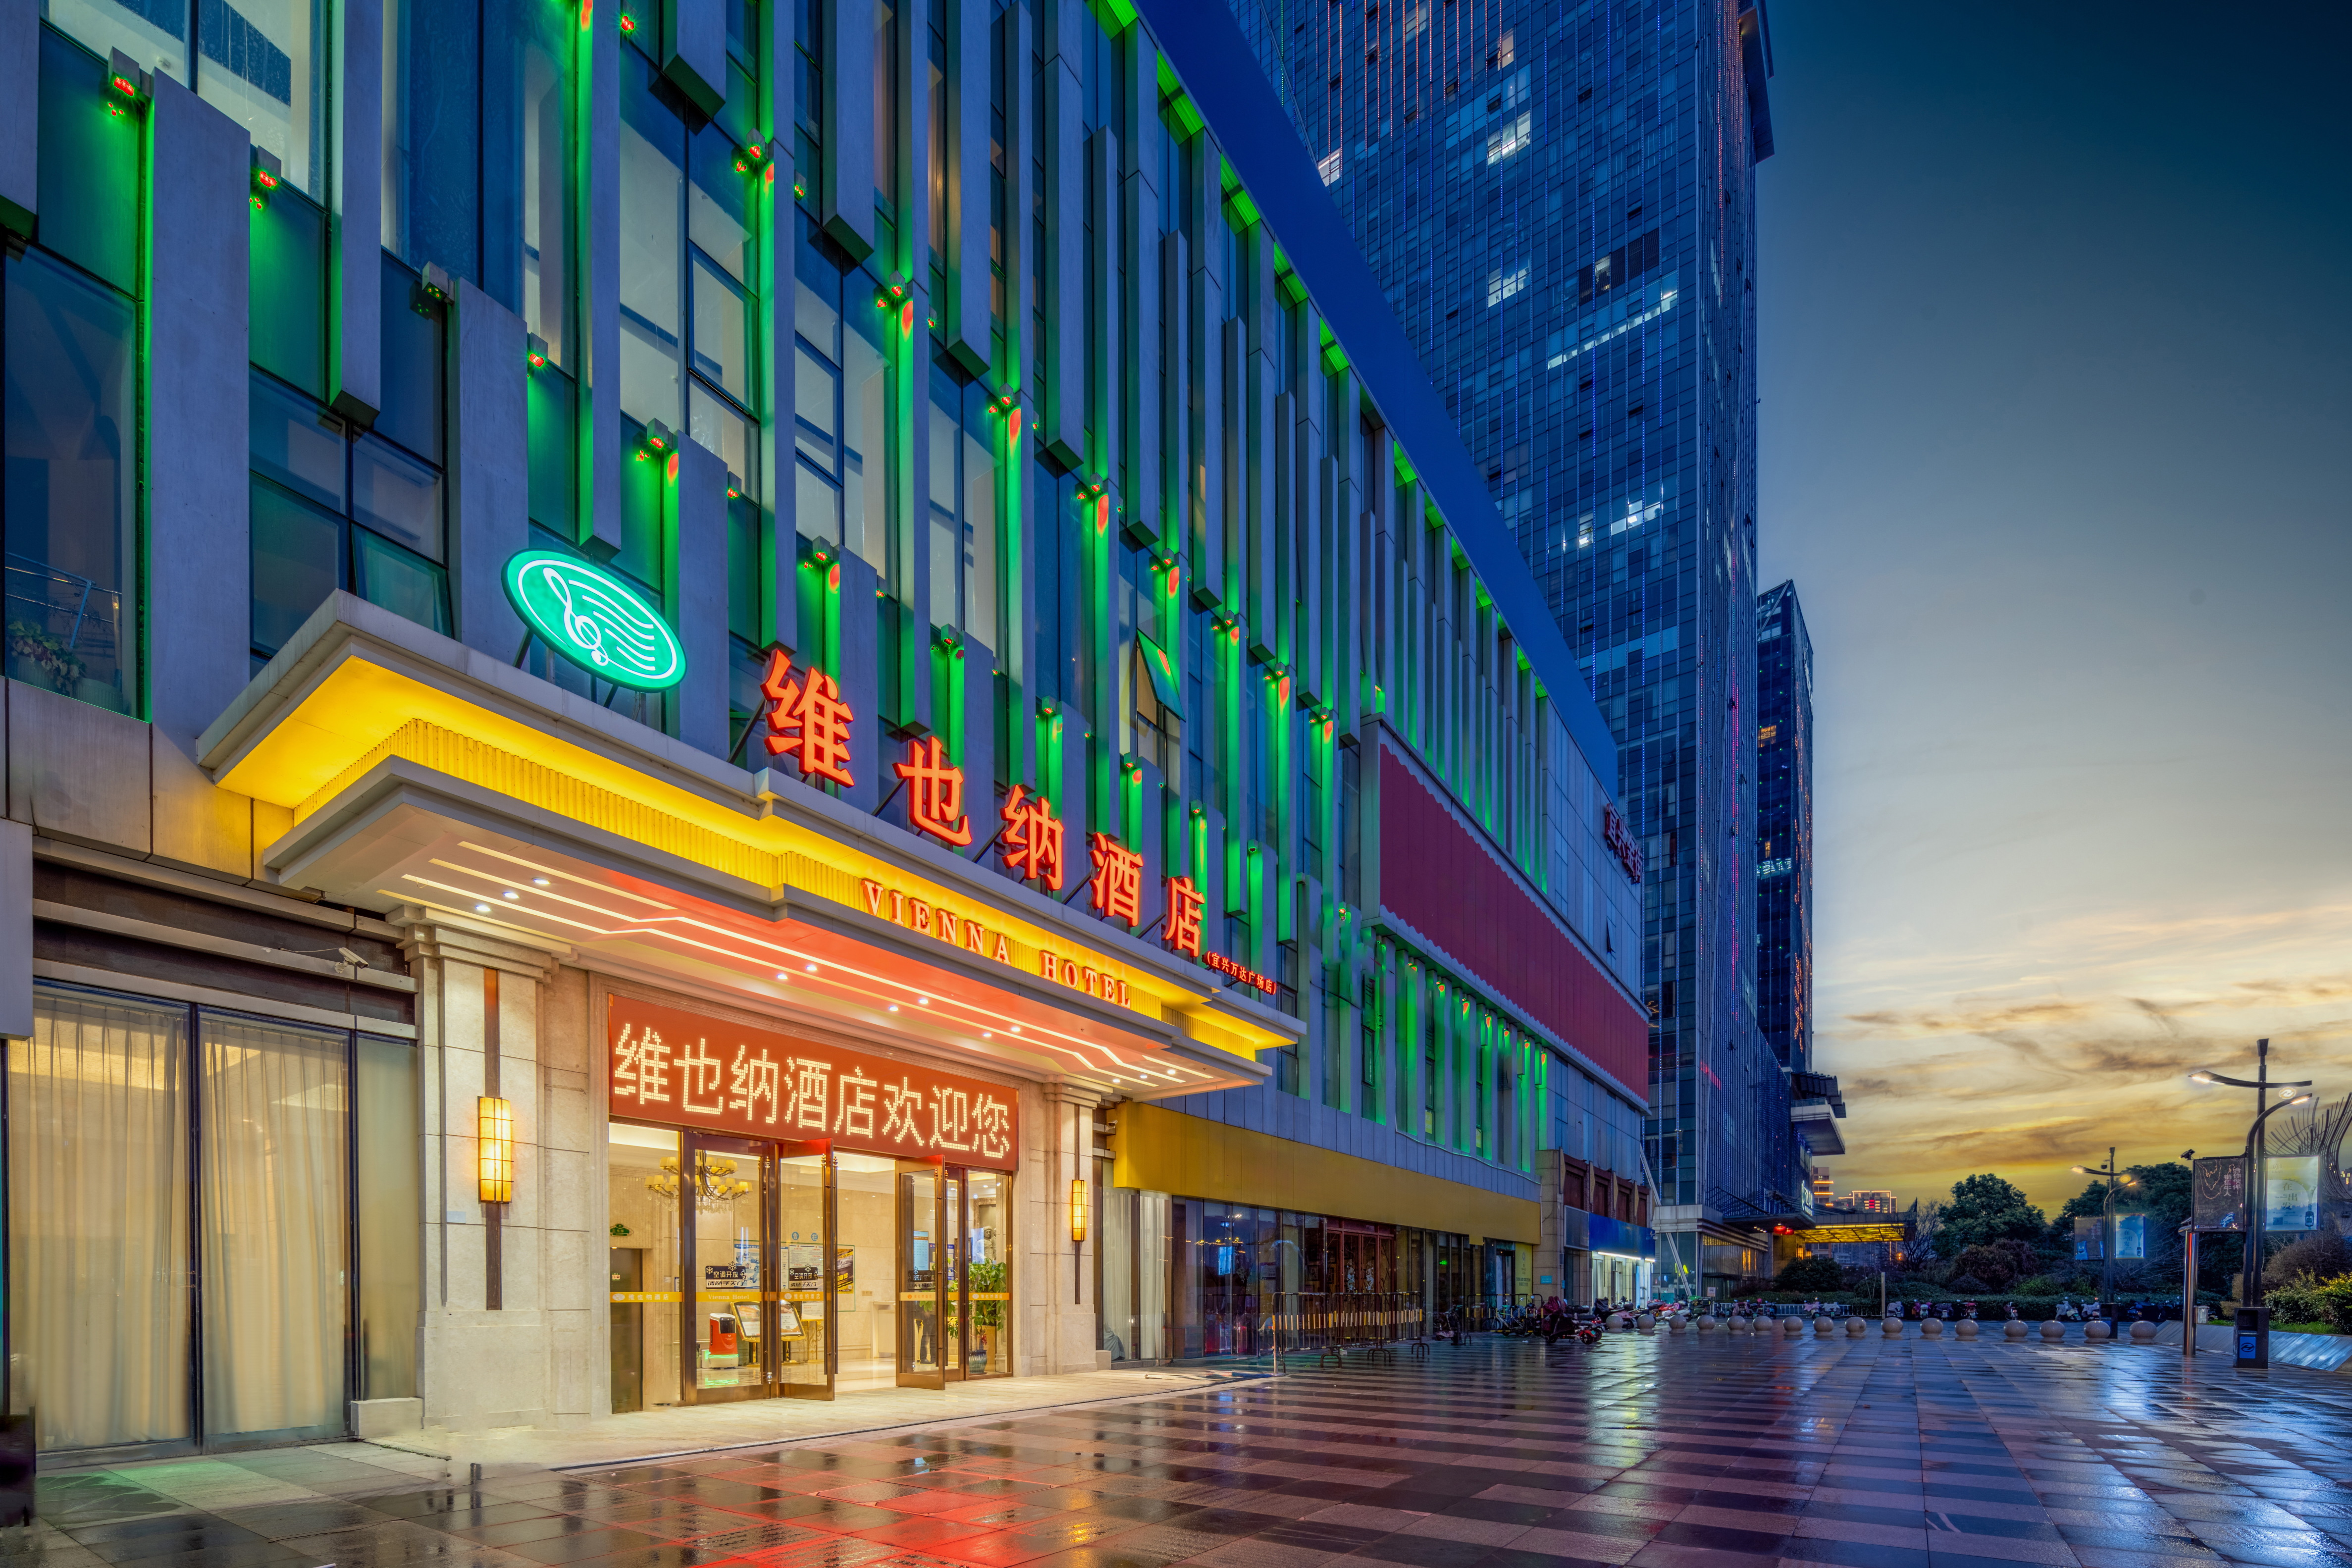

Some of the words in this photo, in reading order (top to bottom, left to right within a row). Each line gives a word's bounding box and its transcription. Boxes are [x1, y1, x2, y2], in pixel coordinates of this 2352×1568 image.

[760, 649, 1205, 957] 维也纳酒店
[861, 879, 1011, 965] VIENNA
[1041, 950, 1131, 1008] HOTEL
[614, 1023, 1010, 1159] 维也纳酒店欢迎您
